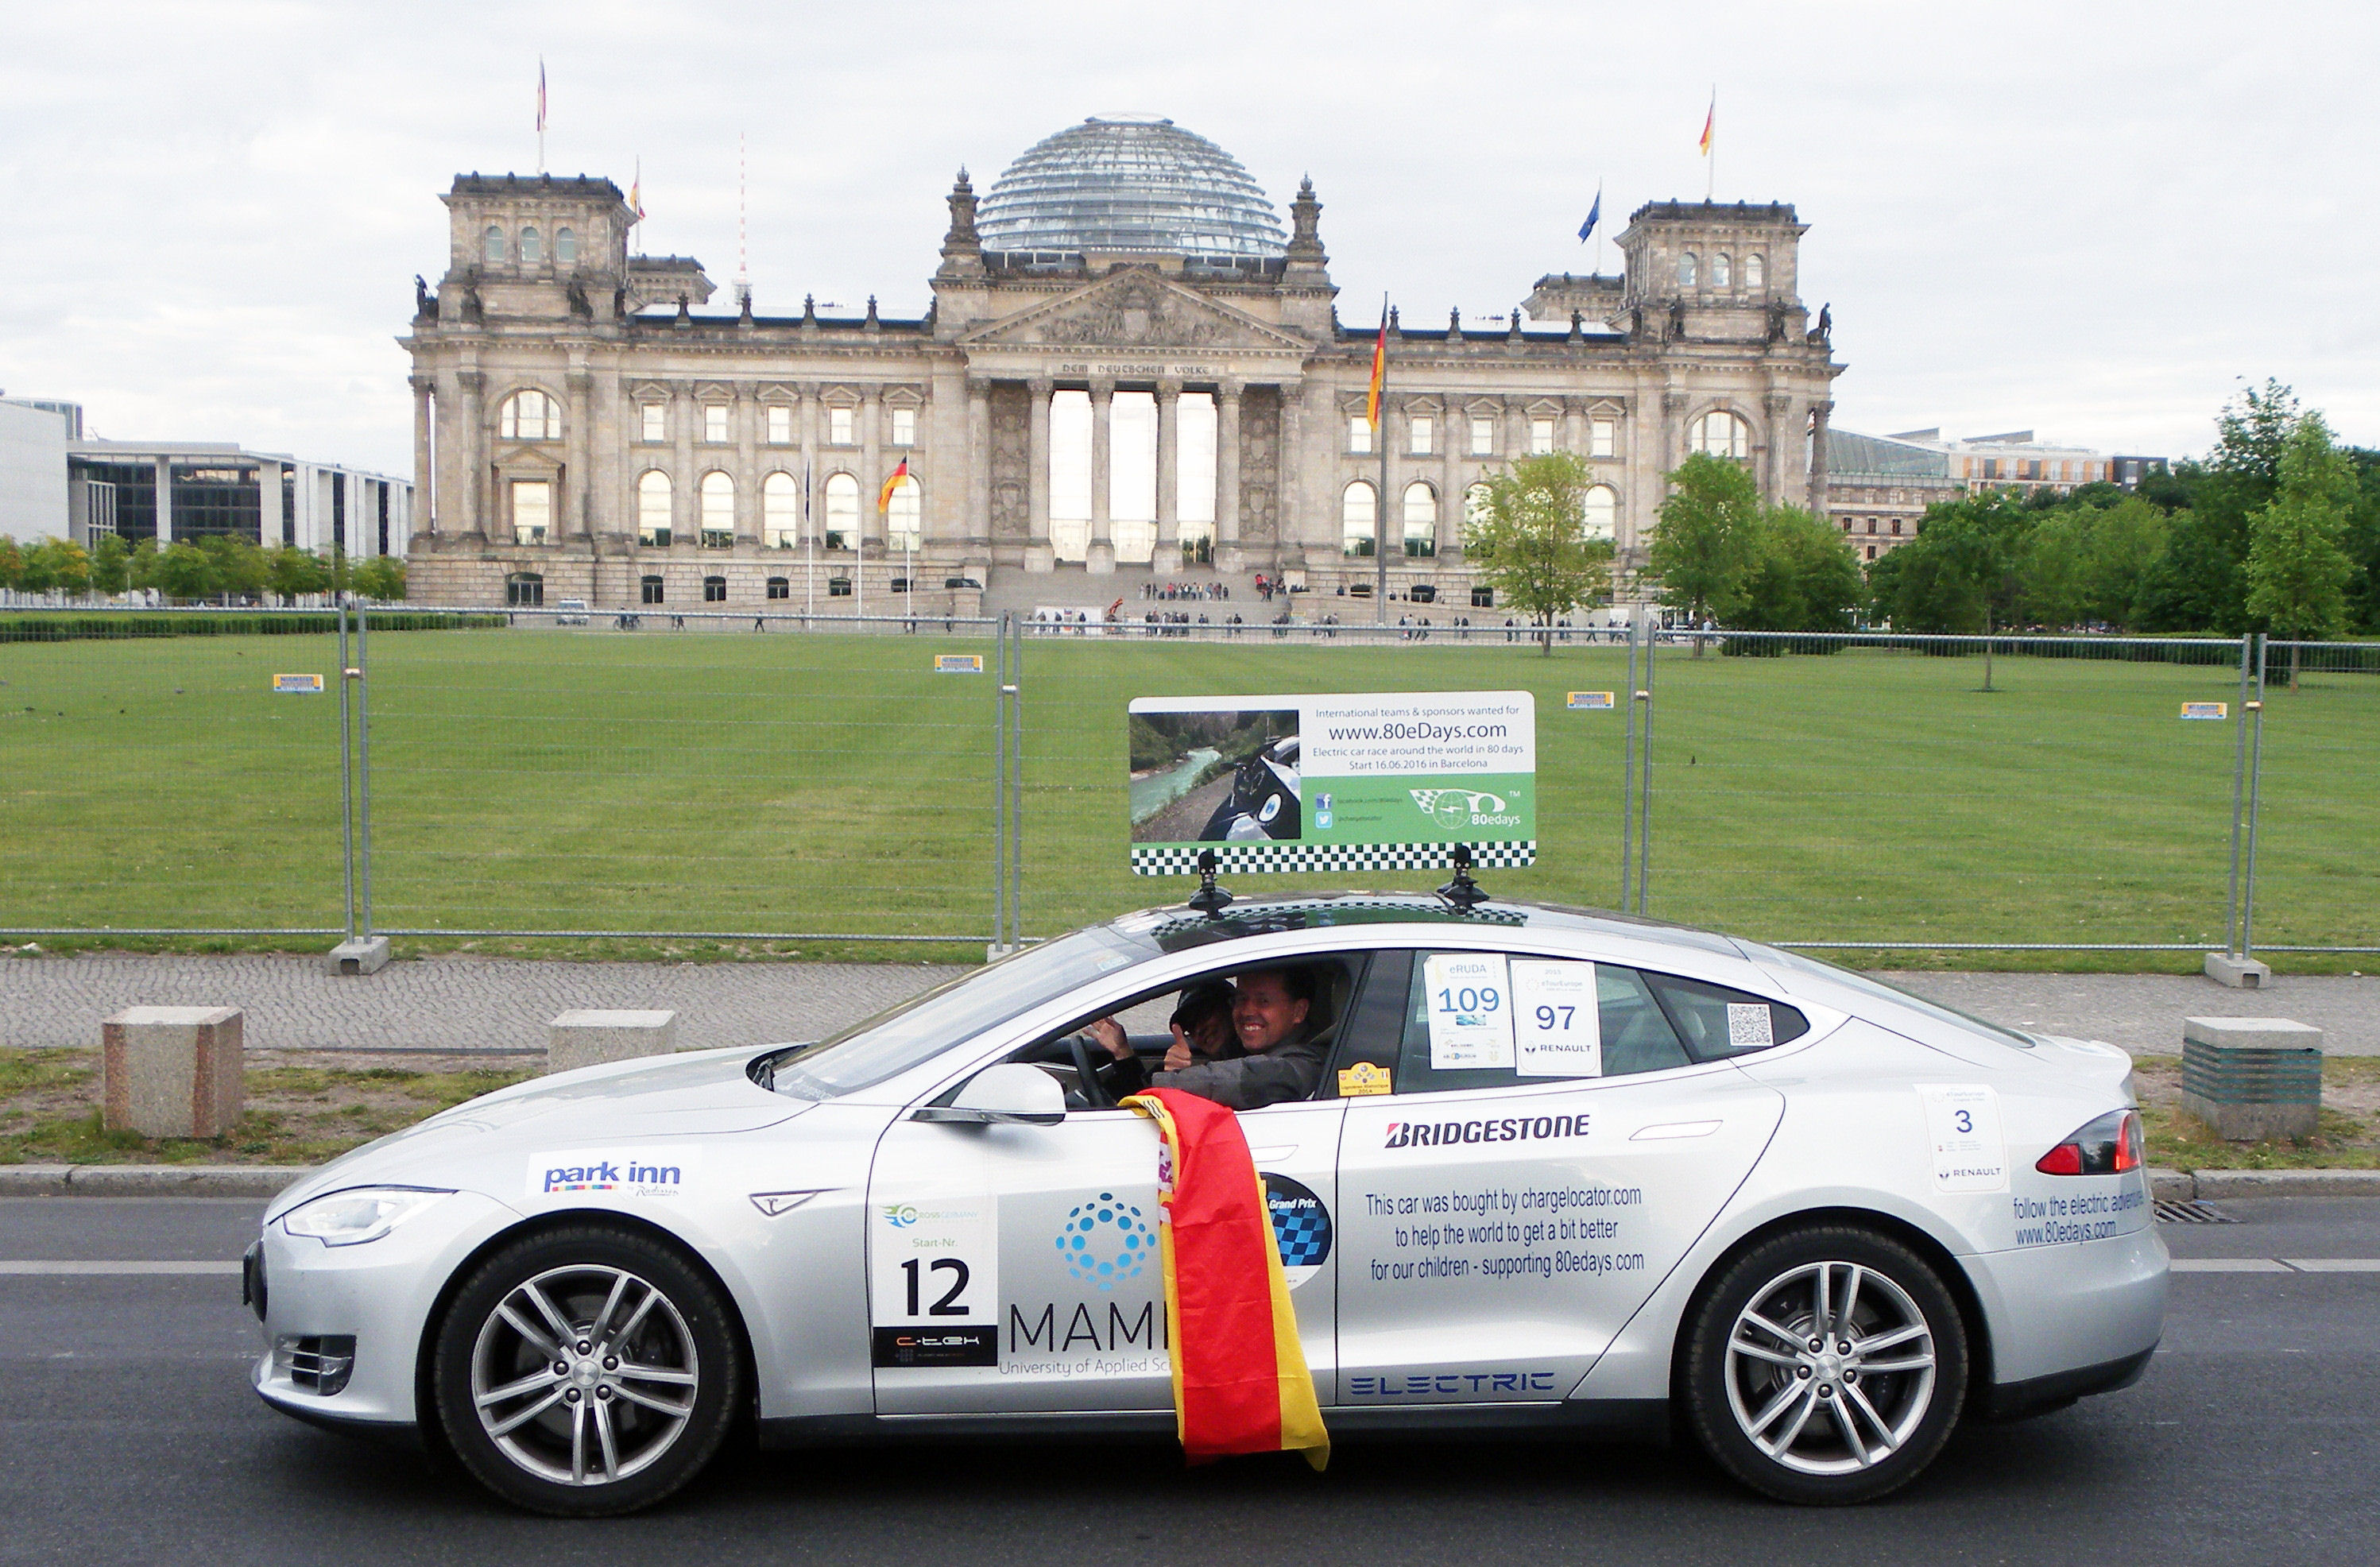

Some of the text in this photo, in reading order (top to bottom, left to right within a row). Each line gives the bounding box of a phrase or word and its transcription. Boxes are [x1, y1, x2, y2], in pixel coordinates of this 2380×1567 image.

[1316, 706, 1519, 719] International teams & sponsors wanted for
[1329, 722, 1507, 742] www.80eDays.com
[1313, 747, 1348, 757] Electric
[1367, 748, 1387, 756] race
[1390, 745, 1425, 756] around
[1427, 745, 1443, 756] the
[1445, 745, 1473, 755] world
[1476, 745, 1485, 754] in
[1487, 745, 1500, 754] 80
[1501, 744, 1523, 755] days
[1349, 759, 1488, 770] Start 16.06.2016 in Barcelona
[1472, 813, 1521, 827] 80edays
[1449, 963, 1487, 974] eRUDA
[1438, 988, 1500, 1013] 109
[1536, 1005, 1576, 1031] 97
[1540, 1044, 1592, 1053] RENAULT
[1384, 1114, 1590, 1148] BRIDGESTONE
[1955, 1109, 1973, 1133] 3
[544, 1161, 681, 1193] park inn
[1952, 1166, 2001, 1178] RENAULT
[1269, 1197, 1317, 1209] Grand Prix
[1365, 1186, 1642, 1217] This car was bought by chargelocator.com
[2014, 1197, 2047, 1220] follow
[2049, 1195, 2067, 1217] the
[2069, 1192, 2109, 1216] electric
[911, 1237, 958, 1248] Start-Nr.
[1395, 1218, 1618, 1250] to help the world to get a bit better
[2015, 1220, 2117, 1246] www.80edays.com
[1371, 1258, 1390, 1281] for
[1392, 1262, 1414, 1280] our
[1417, 1256, 1469, 1278] children
[1482, 1252, 1551, 1279] supporting
[1555, 1250, 1644, 1277] 80edays.com
[901, 1258, 970, 1317] 12
[1010, 1300, 1169, 1353] MAM
[999, 1360, 1070, 1377] University
[1075, 1358, 1092, 1373] of
[1094, 1358, 1147, 1375] Applied
[1351, 1372, 1555, 1395] ELECTRIC
